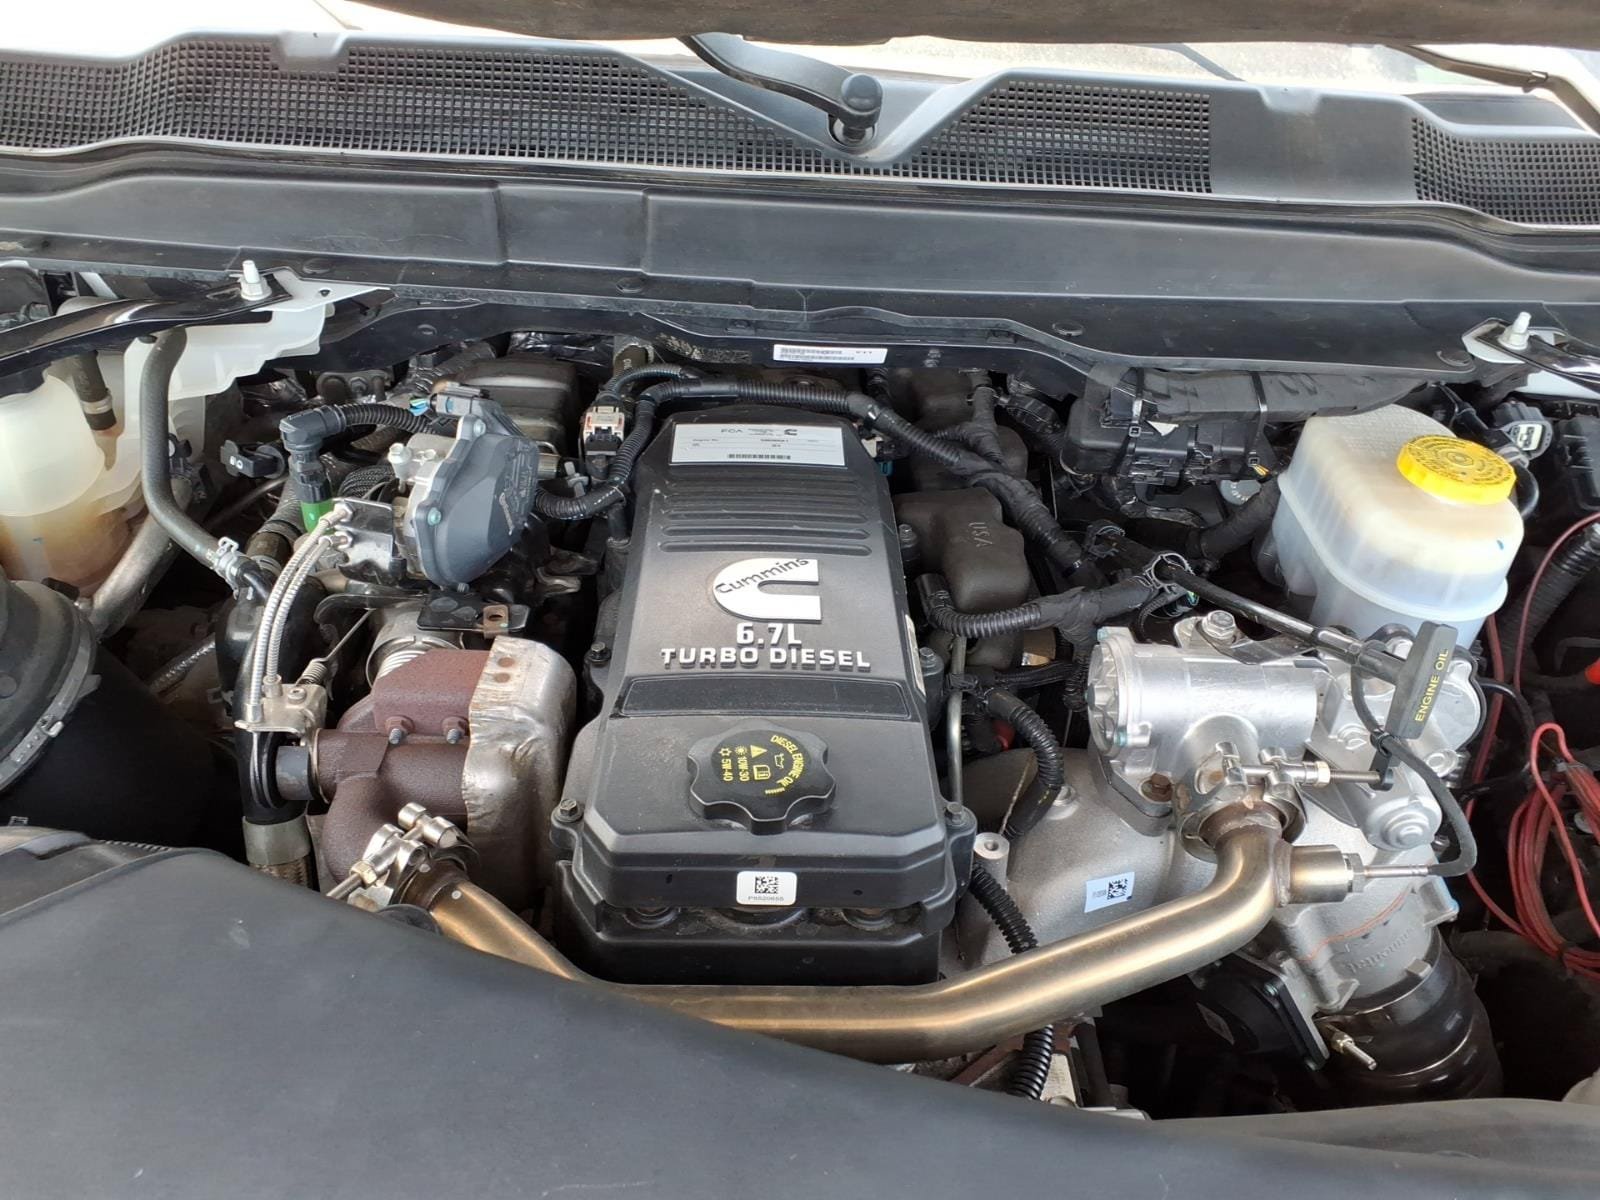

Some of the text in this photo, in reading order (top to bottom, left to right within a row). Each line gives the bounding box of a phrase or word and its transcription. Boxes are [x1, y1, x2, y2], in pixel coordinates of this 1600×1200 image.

[714, 558, 809, 594] Cummins
[736, 622, 802, 648] 6.7L
[660, 647, 871, 672] TURBO DIESEL
[1414, 648, 1449, 722] ENGINE OIL
[721, 758, 734, 782] 5W-40
[770, 734, 805, 787] DIESEL ENGINE OIL
